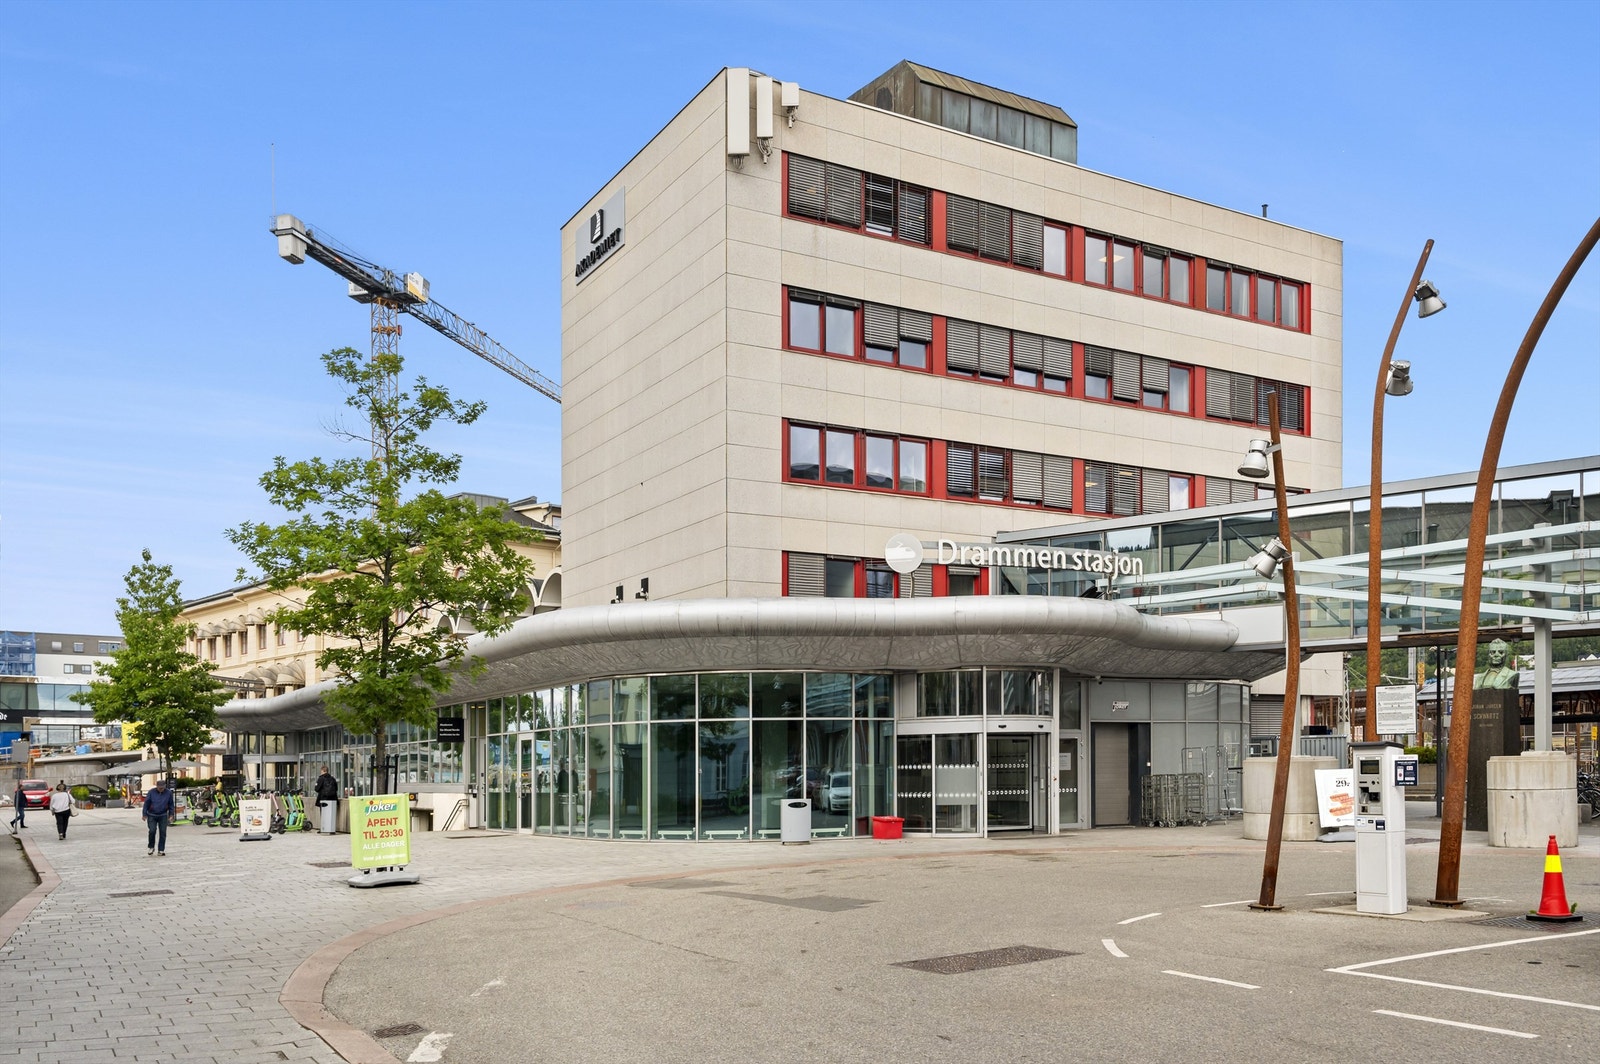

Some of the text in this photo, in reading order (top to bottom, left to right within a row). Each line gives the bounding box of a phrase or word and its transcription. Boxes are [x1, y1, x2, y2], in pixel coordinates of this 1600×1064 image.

[575, 228, 622, 277] AKADEMIET
[938, 539, 1144, 581] Drammen stasjon
[366, 800, 396, 816] joker
[367, 817, 398, 828] ÅPENT
[363, 828, 404, 840] TIL 23:30
[363, 840, 405, 850] ALLE DAGER
